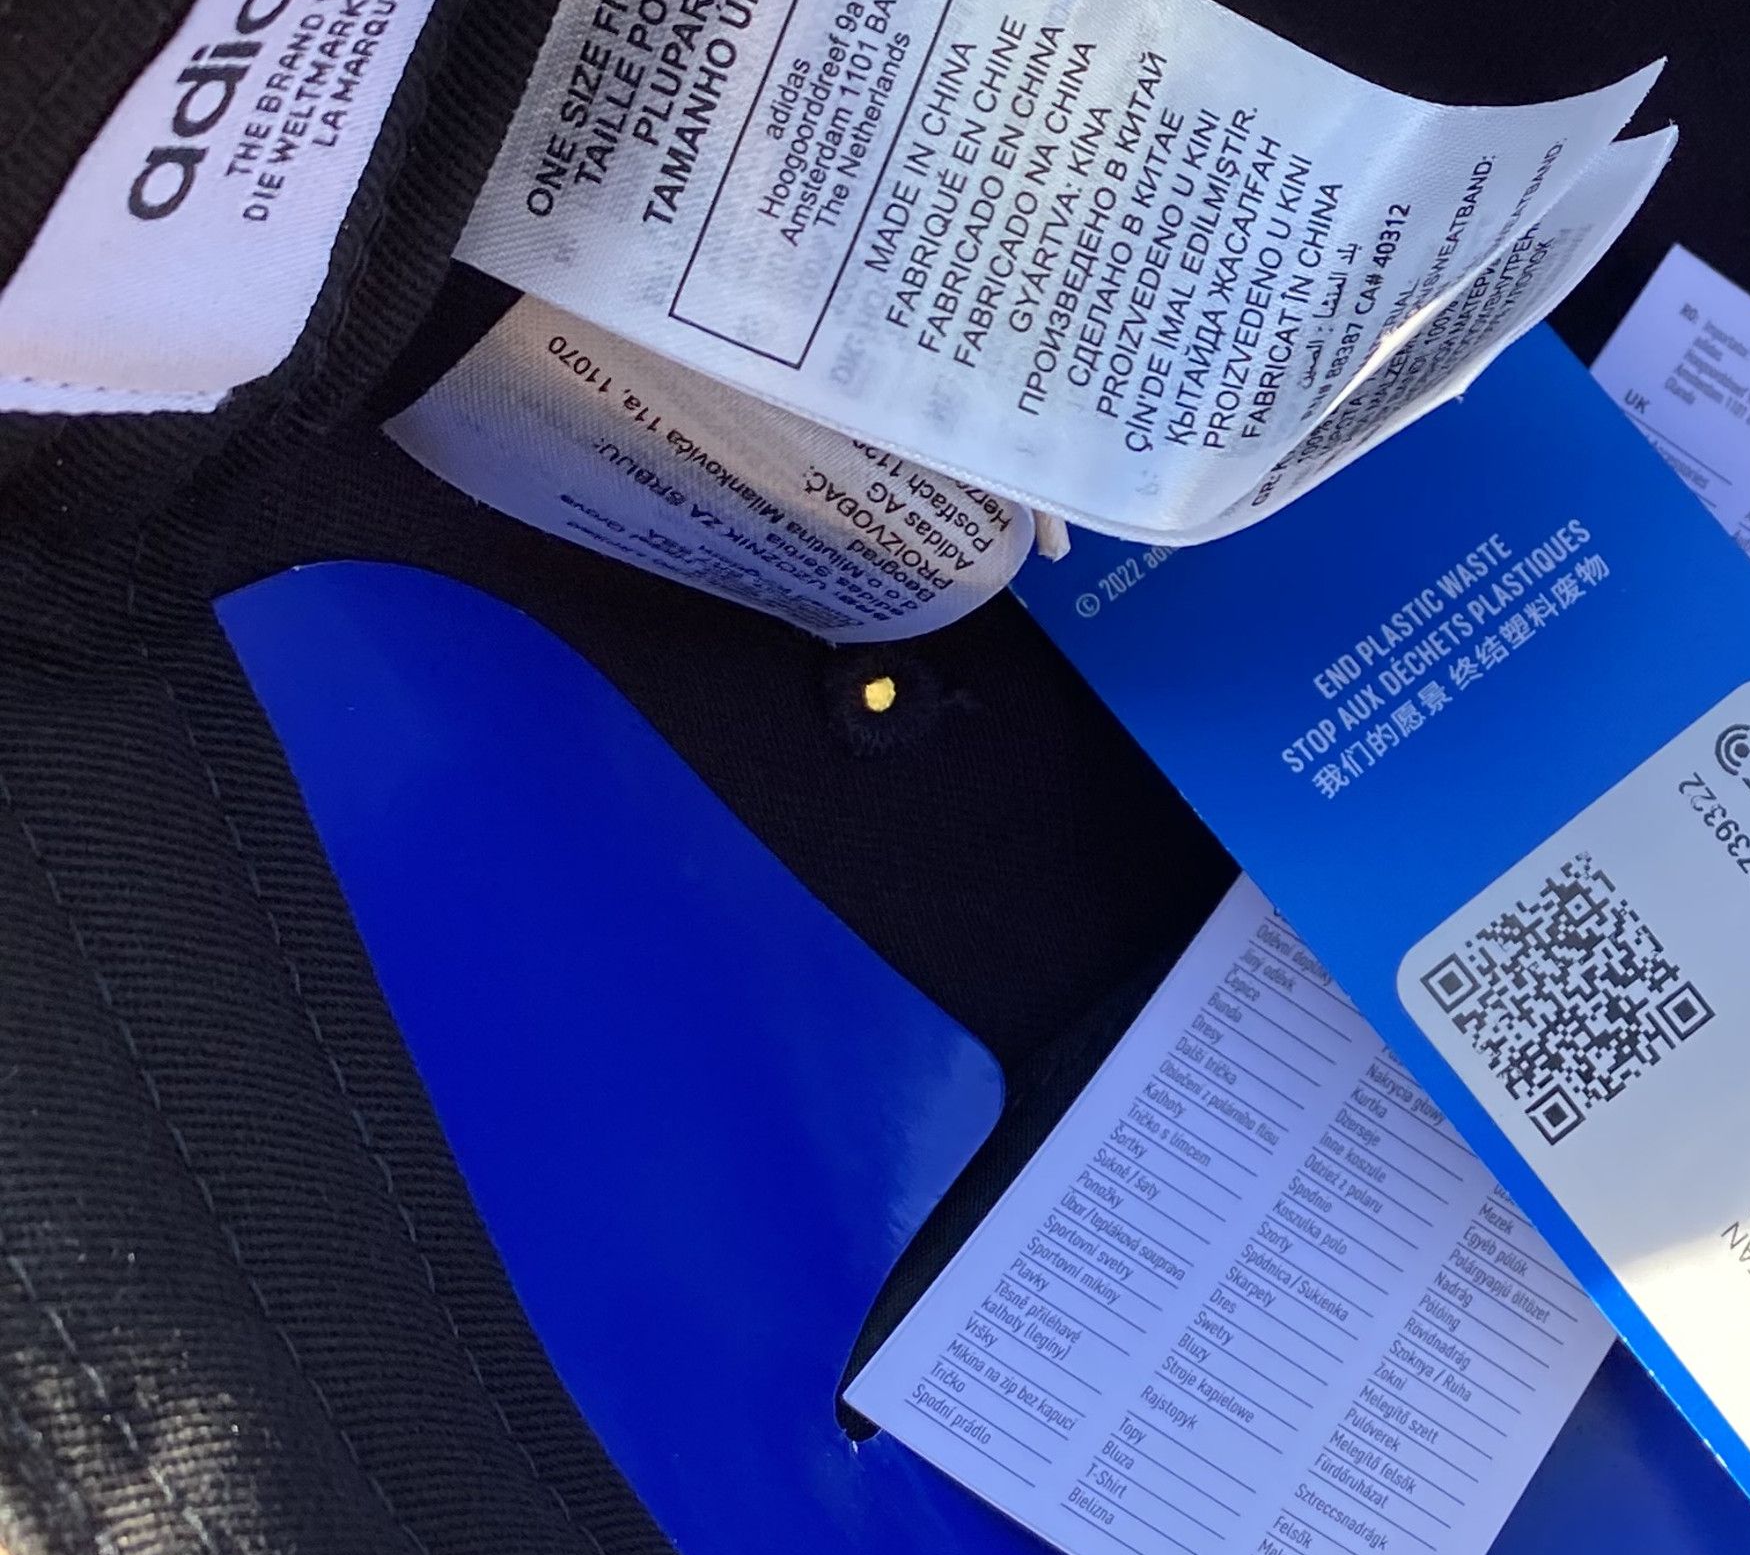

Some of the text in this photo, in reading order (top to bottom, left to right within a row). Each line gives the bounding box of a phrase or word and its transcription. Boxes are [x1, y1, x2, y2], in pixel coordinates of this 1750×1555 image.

[224, 123, 272, 177] THE
[255, 13, 325, 114] BRAND
[310, 108, 349, 149] LA
[525, 132, 579, 218] ONE
[559, 39, 613, 129] SIZE
[573, 56, 646, 185] TAILLE
[642, 37, 737, 225] TAMANHO
[757, 0, 866, 220] Hoogoorddreef 9a
[764, 57, 812, 142] adidas
[779, 106, 854, 247] Amsterdam
[838, 38, 880, 98] 1101
[811, 32, 911, 228] The Netherlands
[863, 43, 978, 274] MADE IN CHINA
[884, 14, 1027, 329] FABRIQUÉ EN CHINE
[241, 171, 286, 223] DIE
[917, 26, 1065, 354] FABRICADO EN CHINA
[952, 43, 1097, 369] FABRICADO NA CHINA
[1008, 107, 1113, 334] GYÁRTVA: KÍNA
[1017, 51, 1168, 416] ПРОИЗВЕДЕНО В КИТАЙ
[1067, 107, 1185, 388] СДЕЛАНО В КИТАЕ
[1095, 107, 1222, 419] PROIZVEDENO U KINI
[1124, 107, 1258, 453] ÇİN'DE İMAL EDİLMİŞTİR.
[1353, 272, 1385, 317] CA#
[1371, 203, 1412, 270] 40312
[547, 335, 612, 393] 11070
[1202, 152, 1314, 449] PROIZVEDENO U KINI
[1240, 183, 1344, 439] FABRICAT ÎN CHINA
[622, 387, 663, 434] 11a,
[1622, 388, 1651, 416] UK
[804, 465, 955, 591] PROIZVOĐAČ:
[865, 480, 908, 516] AG
[903, 510, 975, 571] Adidas
[906, 473, 995, 554] Postfach
[1097, 556, 1146, 603] 2022
[1281, 519, 1591, 773] STOP AUX DÉCHETS PLASTIQUES
[1311, 554, 1610, 800] 我们的愿景 终结塑料废物
[1312, 533, 1512, 701] END PLASTIC WASTE
